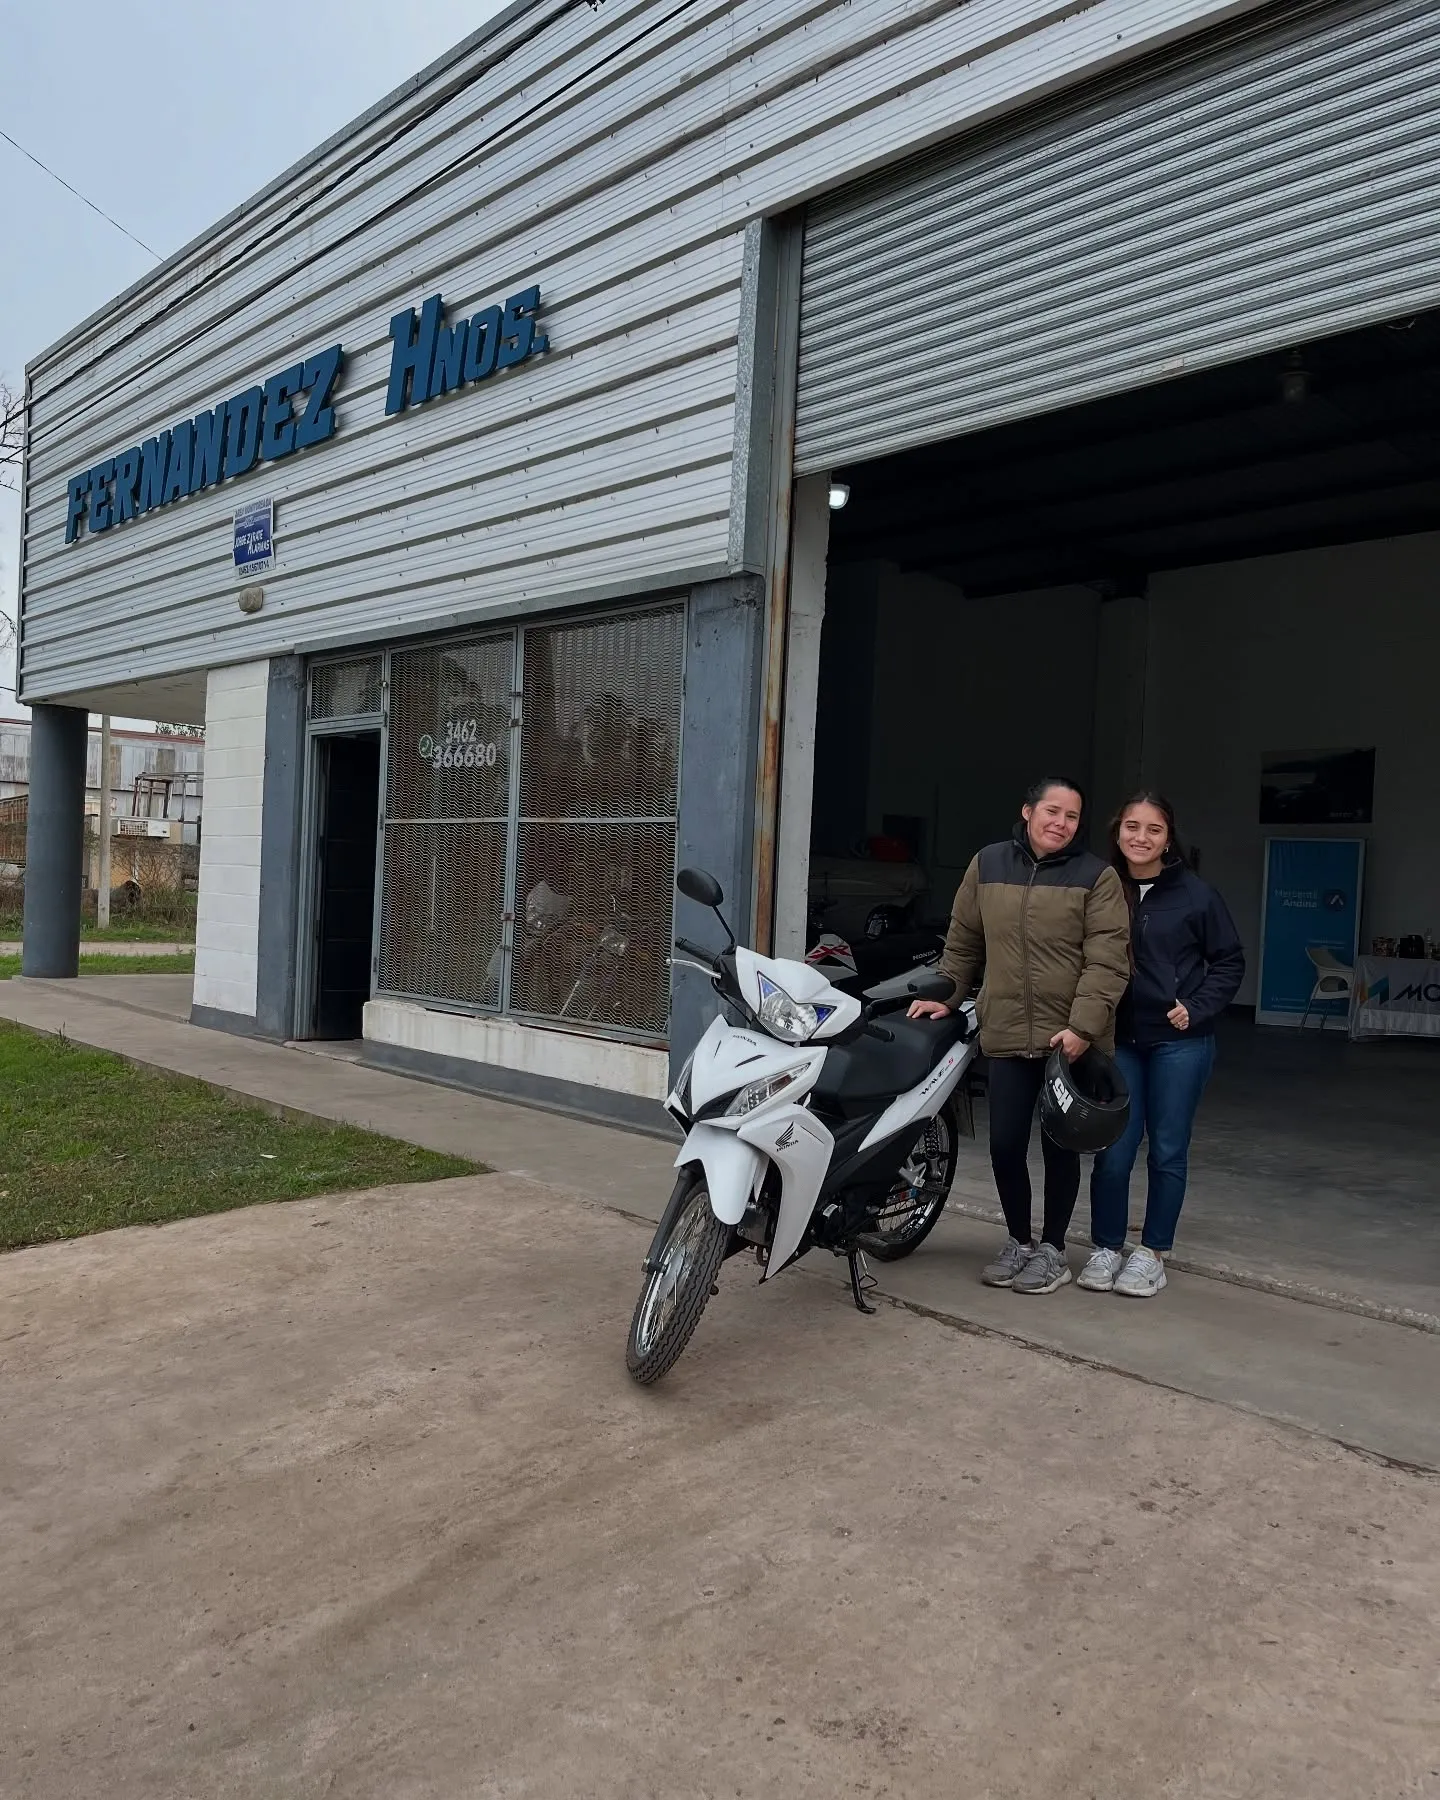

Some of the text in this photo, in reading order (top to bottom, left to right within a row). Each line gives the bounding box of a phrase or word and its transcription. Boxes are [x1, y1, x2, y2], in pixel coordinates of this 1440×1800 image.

[64, 343, 345, 544] FERNANDEZ
[446, 720, 477, 743] 3462
[432, 743, 497, 768] 366680
[912, 949, 937, 961] HONDA
[776, 1139, 799, 1152] HONDA
